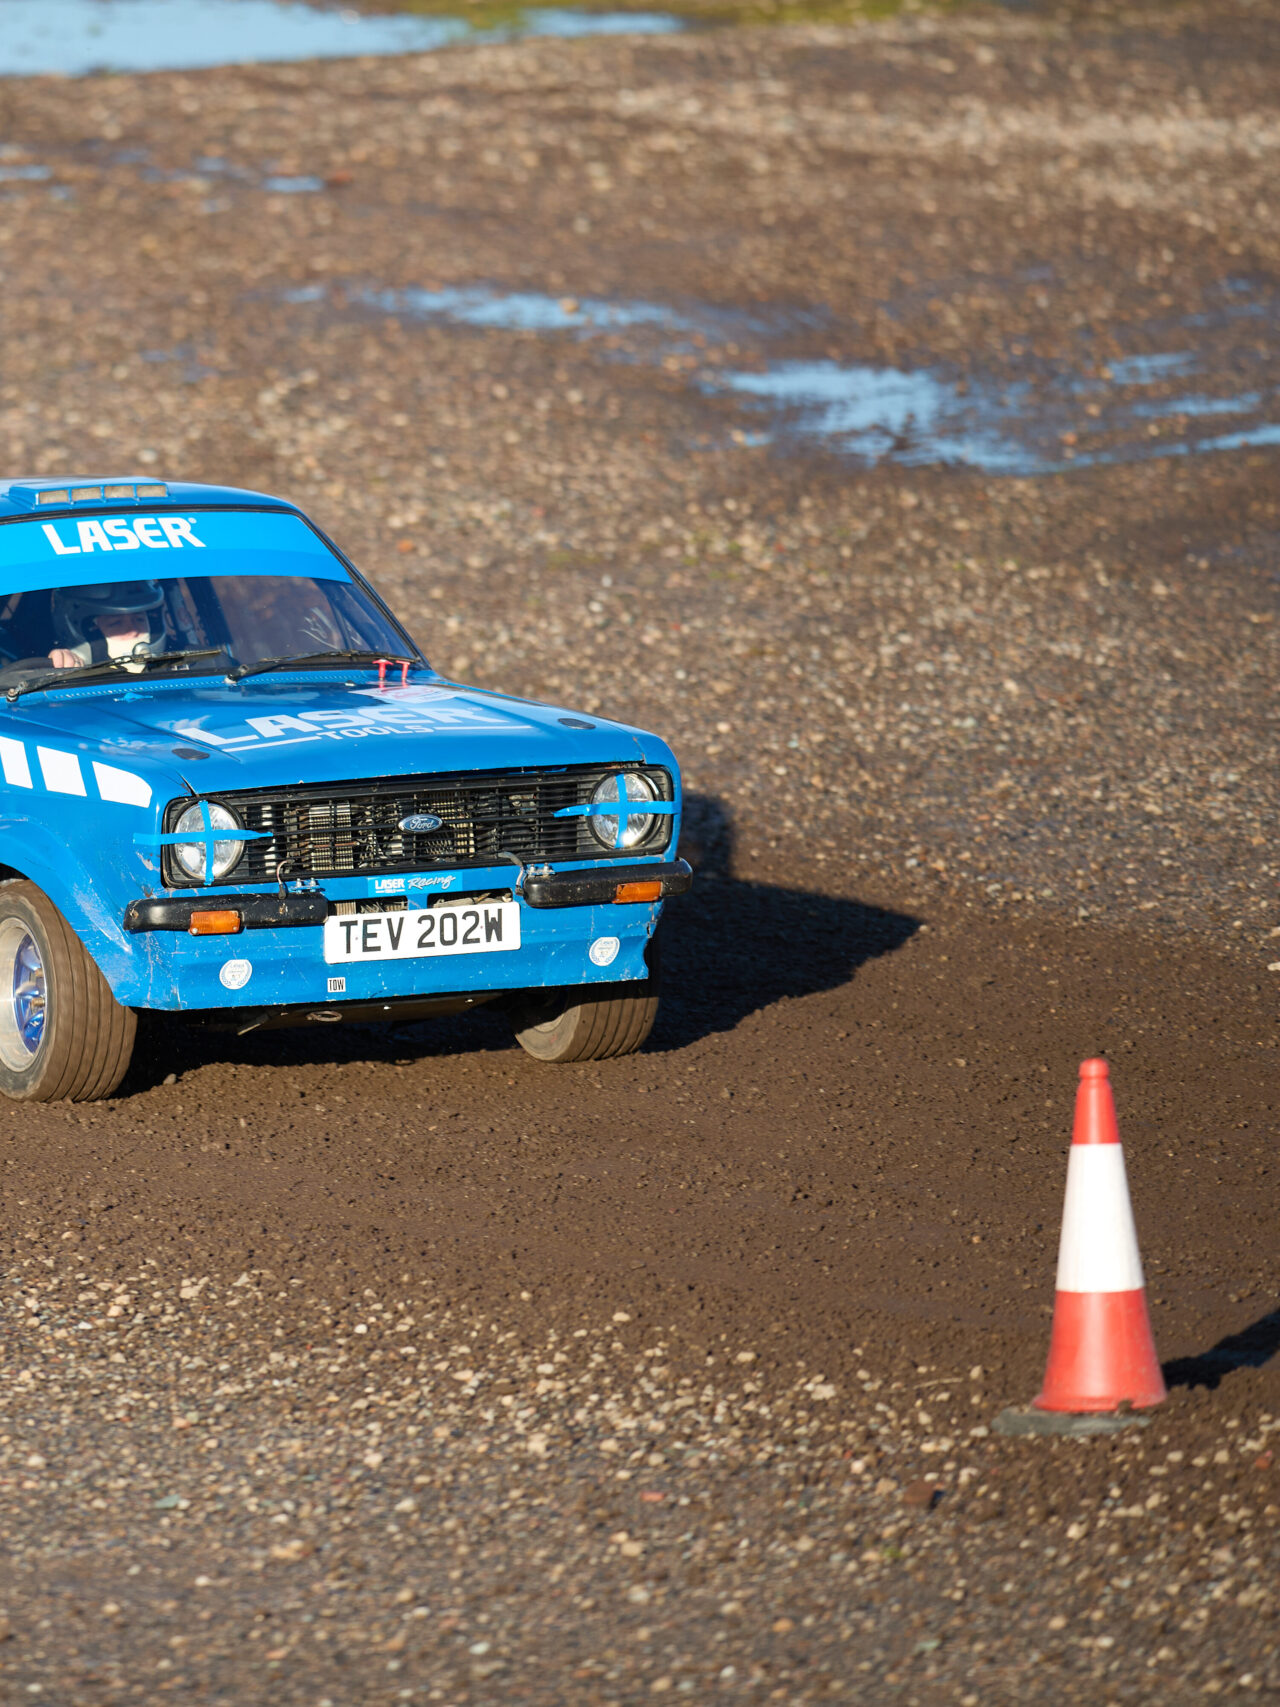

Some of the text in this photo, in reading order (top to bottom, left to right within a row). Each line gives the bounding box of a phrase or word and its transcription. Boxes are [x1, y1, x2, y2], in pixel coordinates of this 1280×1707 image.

[41, 517, 207, 555] LASER
[177, 707, 511, 746] LASER
[317, 725, 436, 740] TOOLS
[409, 816, 434, 829] Ford
[375, 875, 456, 890] LASER Racing
[339, 908, 503, 954] TEV 202W
[329, 978, 344, 991] TOW
